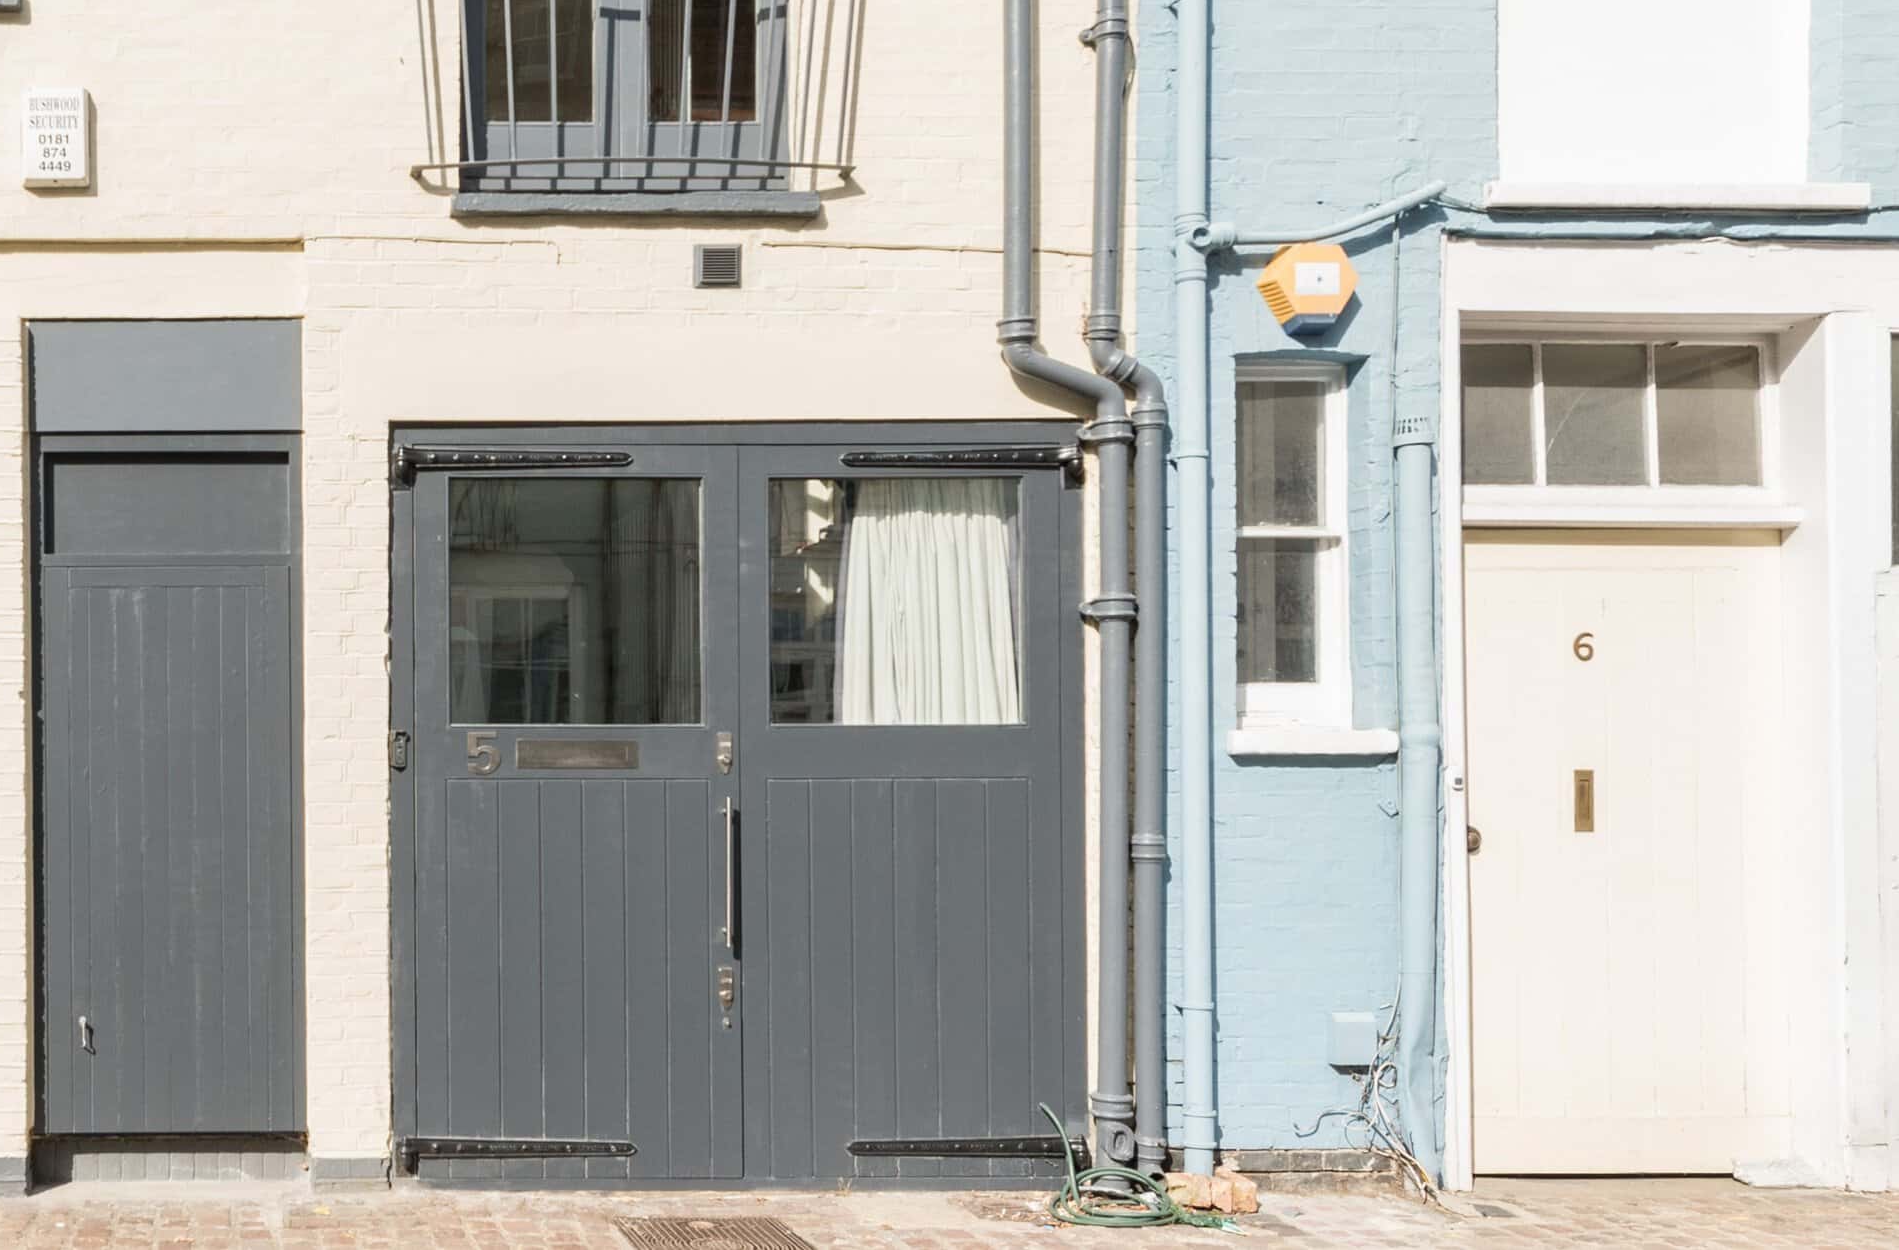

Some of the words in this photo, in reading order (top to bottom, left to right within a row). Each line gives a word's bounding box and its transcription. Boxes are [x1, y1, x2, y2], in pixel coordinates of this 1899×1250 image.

[28, 115, 79, 129] SECURITY
[38, 133, 69, 145] 0181
[43, 147, 67, 158] 874
[38, 160, 72, 172] 4449
[1573, 632, 1594, 662] 6
[467, 731, 501, 775] 5
